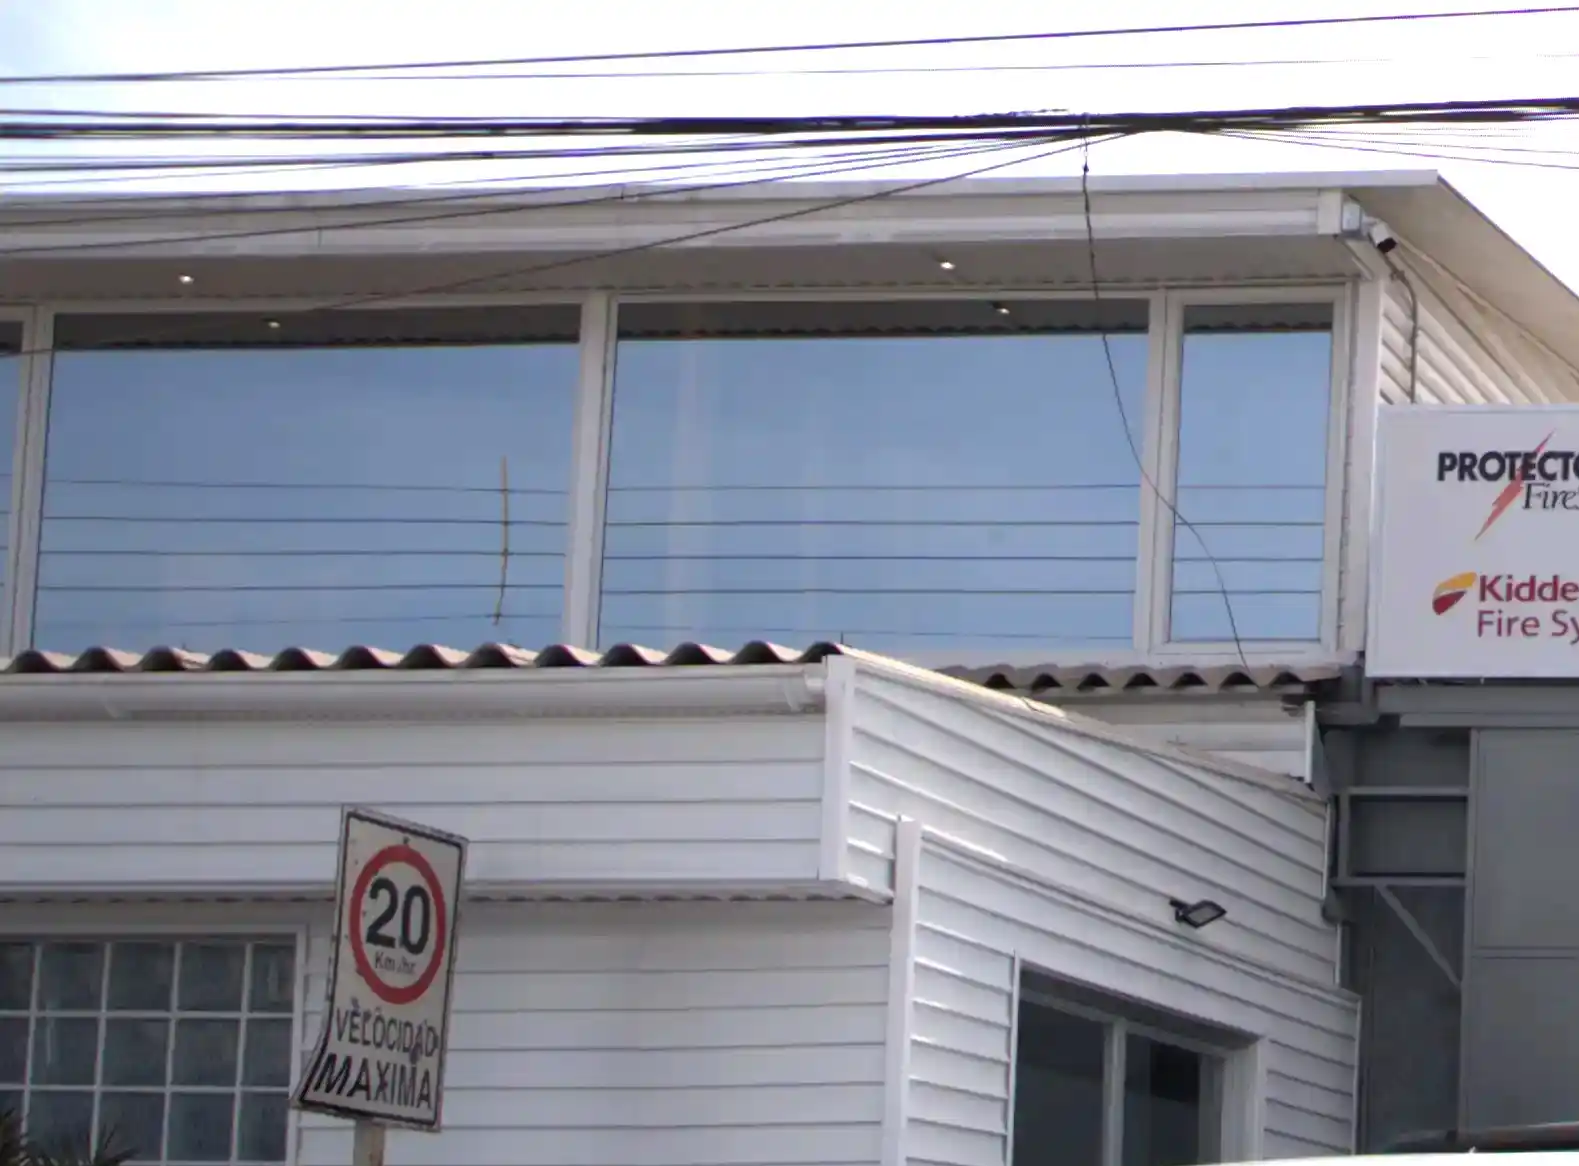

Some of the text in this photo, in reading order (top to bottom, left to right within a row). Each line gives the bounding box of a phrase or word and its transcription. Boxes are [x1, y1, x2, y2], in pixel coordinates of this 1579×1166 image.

[1479, 574, 1579, 603] Kidde
[1477, 609, 1541, 638] Fire
[366, 877, 430, 955] 20
[335, 1005, 438, 1058] VELOCIDAD
[313, 1052, 432, 1110] MAXIMA
